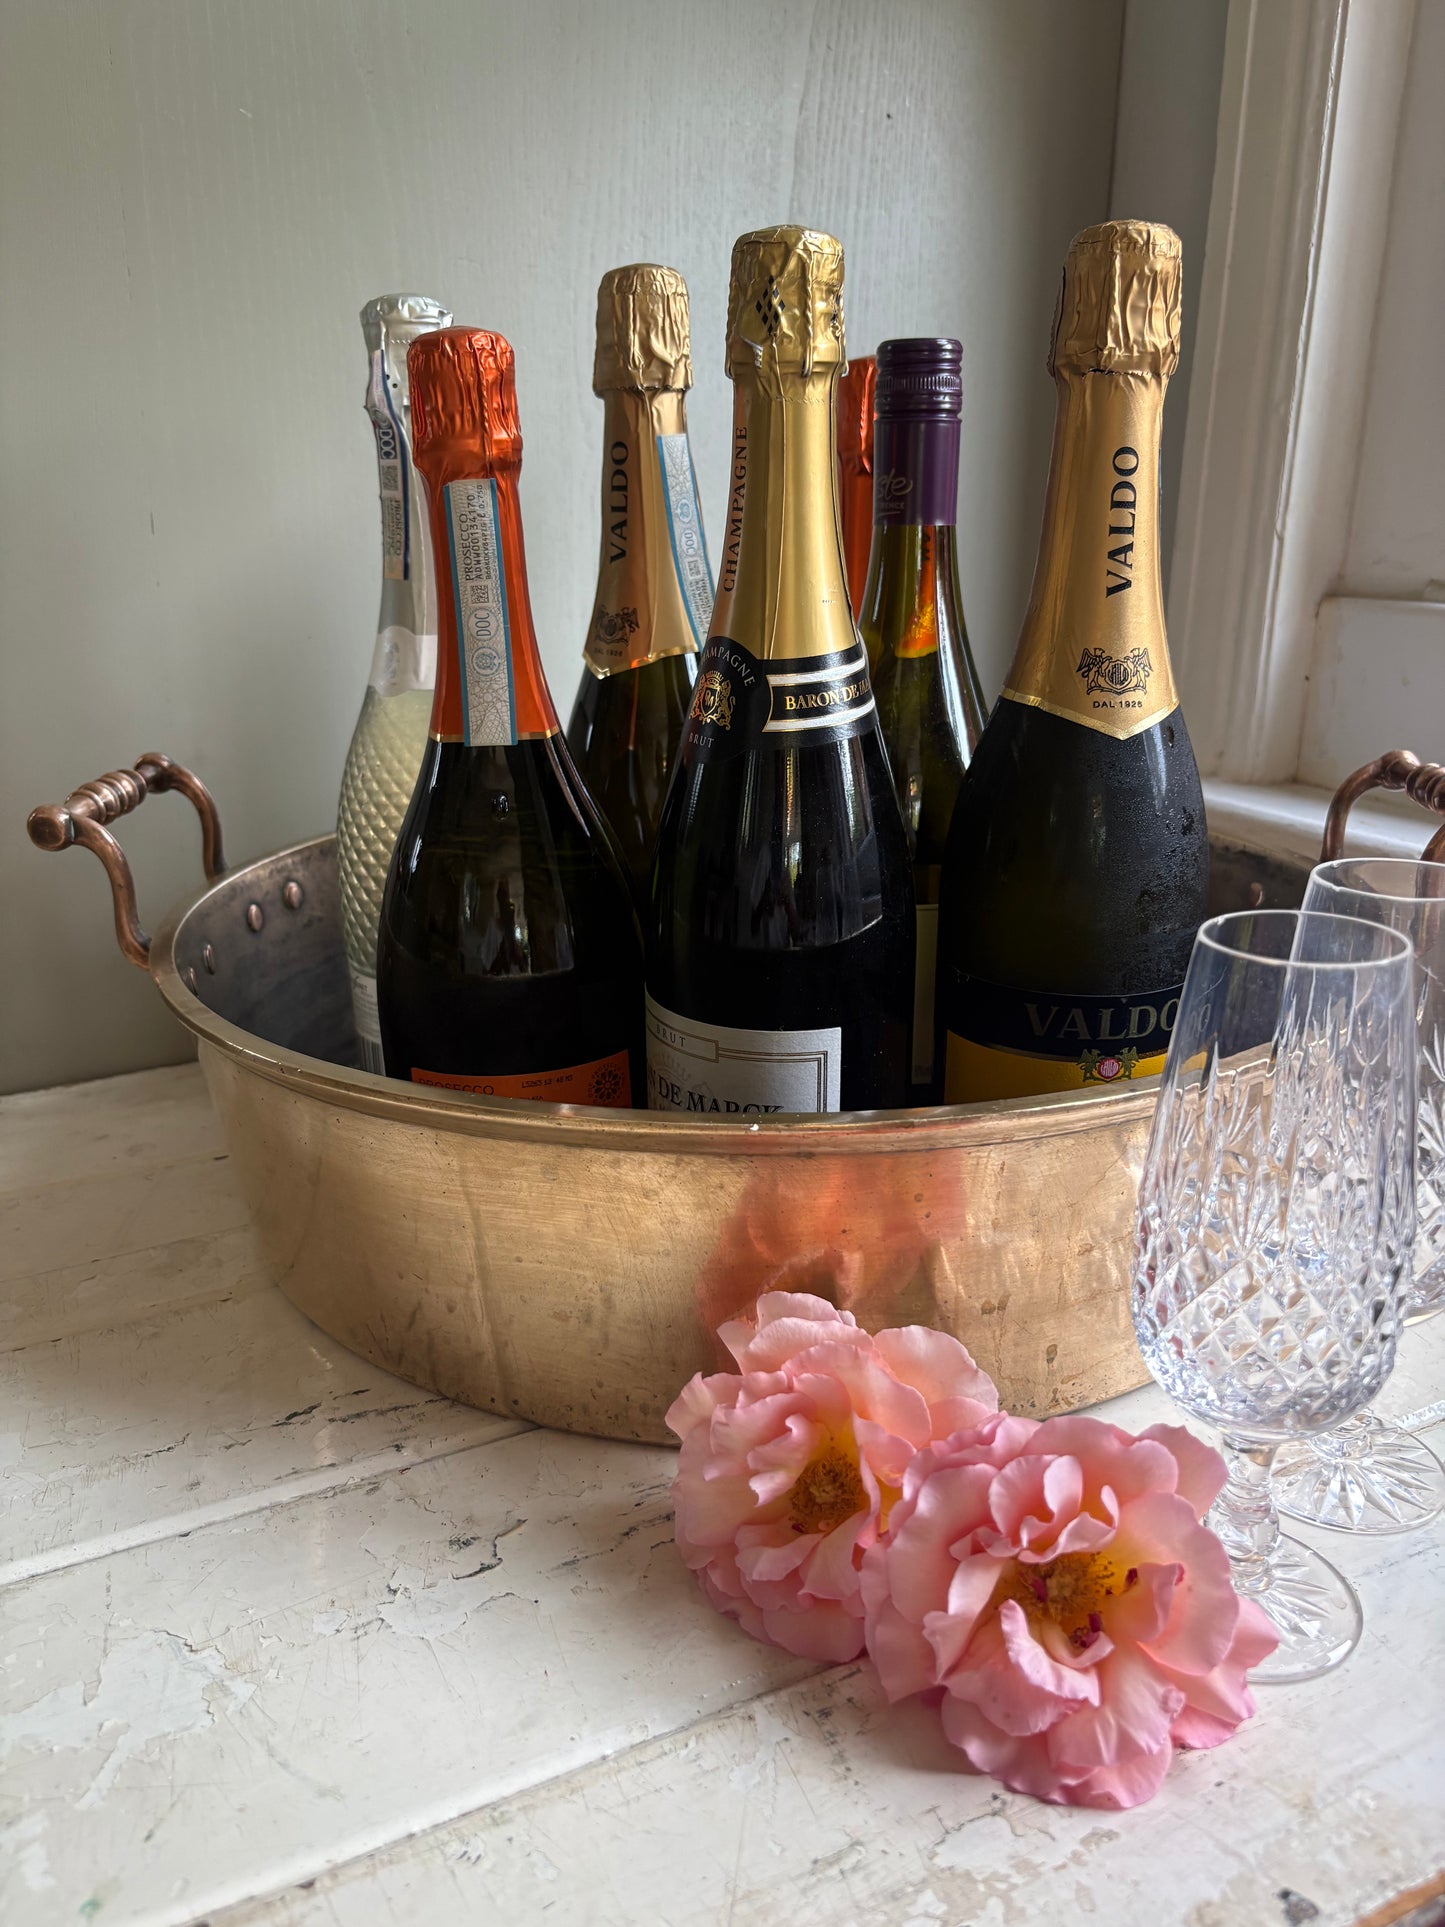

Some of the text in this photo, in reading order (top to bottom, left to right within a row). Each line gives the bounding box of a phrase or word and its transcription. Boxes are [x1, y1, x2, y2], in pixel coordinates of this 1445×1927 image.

[379, 429, 396, 459] DOC
[877, 468, 914, 501] ste
[609, 441, 629, 564] VALDO
[722, 426, 748, 593] CHAMPAGNE
[1105, 445, 1140, 598] VALDO
[459, 513, 474, 582] PROSECCO
[683, 532, 697, 554] DOC
[474, 612, 492, 637] DOC
[703, 646, 756, 687] AMPAGNE
[785, 689, 840, 710] BARON
[840, 683, 860, 703] DE
[1093, 700, 1116, 709] DAL
[688, 732, 716, 749] BRUT
[1024, 997, 1181, 1041] VALDO
[656, 1023, 687, 1048] BRUT
[658, 1075, 682, 1106] DE
